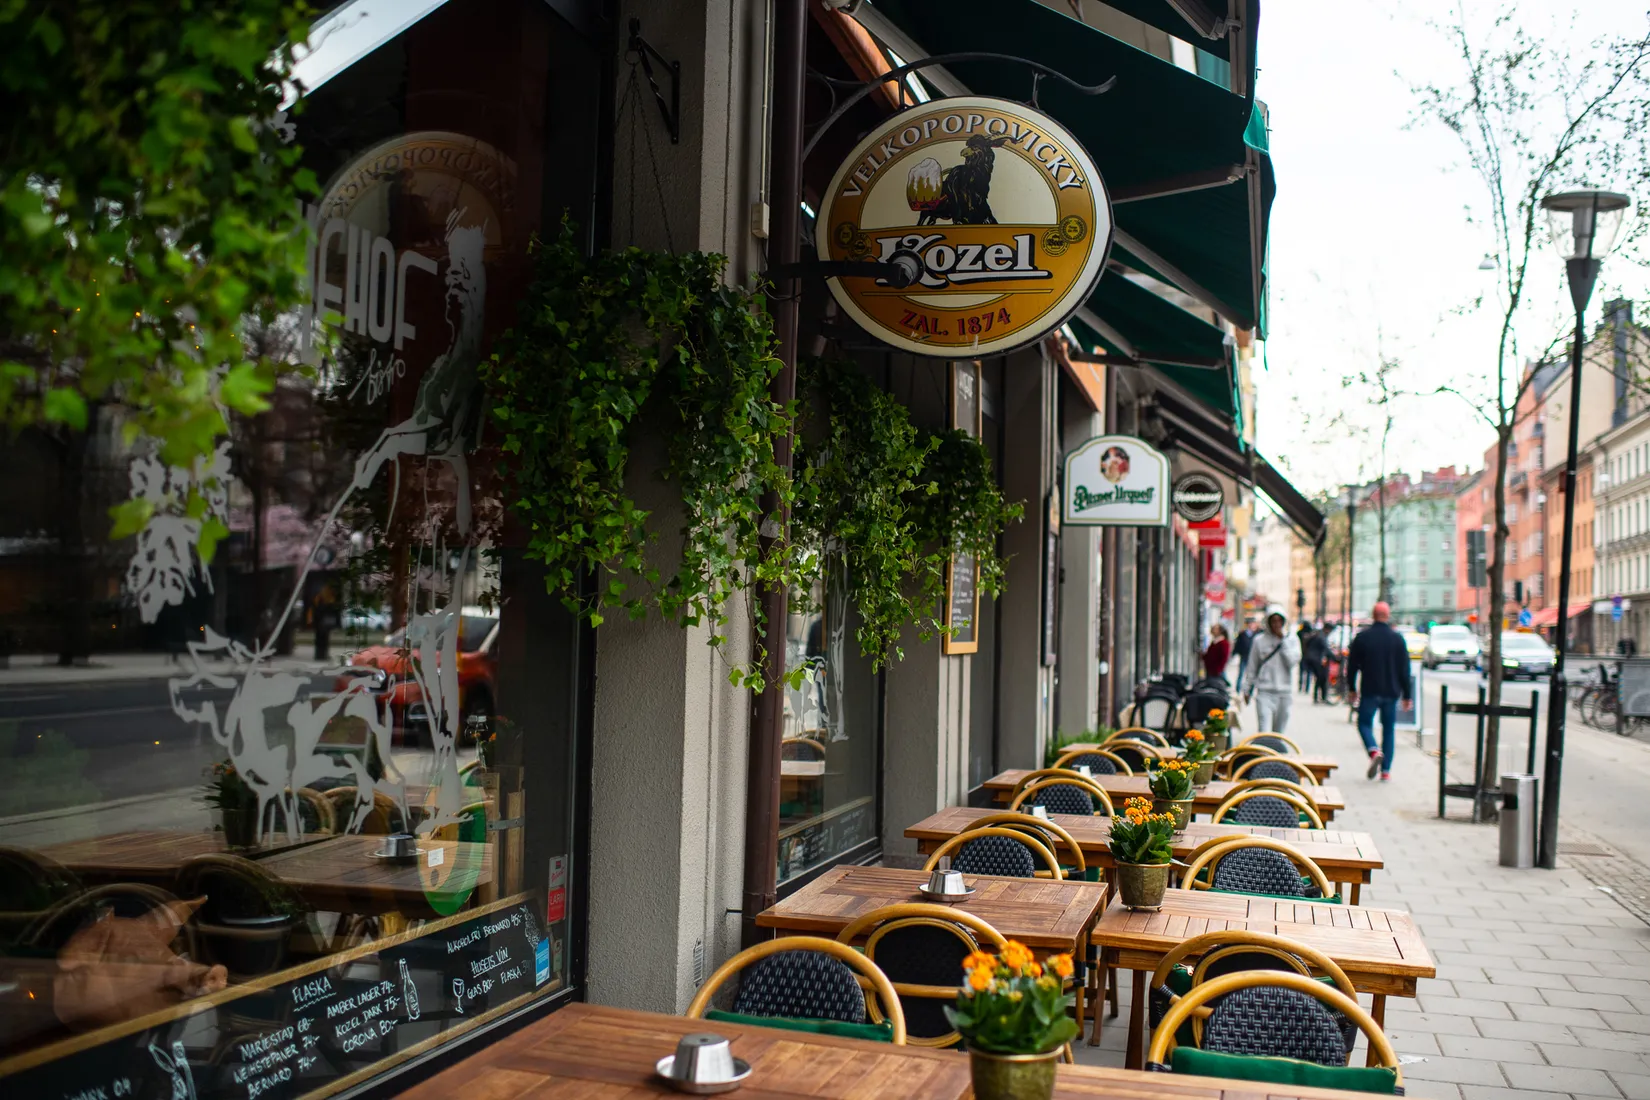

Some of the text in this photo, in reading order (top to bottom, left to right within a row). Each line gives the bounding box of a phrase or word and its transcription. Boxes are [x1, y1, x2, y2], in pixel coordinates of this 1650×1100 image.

[875, 233, 1036, 288] Kozel
[900, 307, 1012, 336] ZAL. 1874
[291, 976, 333, 1005] FLASKA
[326, 999, 358, 1019] AMBER
[357, 985, 382, 1006] LAGER
[335, 1018, 361, 1038] KOZEL
[362, 1003, 384, 1023] DARK
[343, 1027, 378, 1054] CORONA
[246, 1066, 293, 1100] BERNARD
